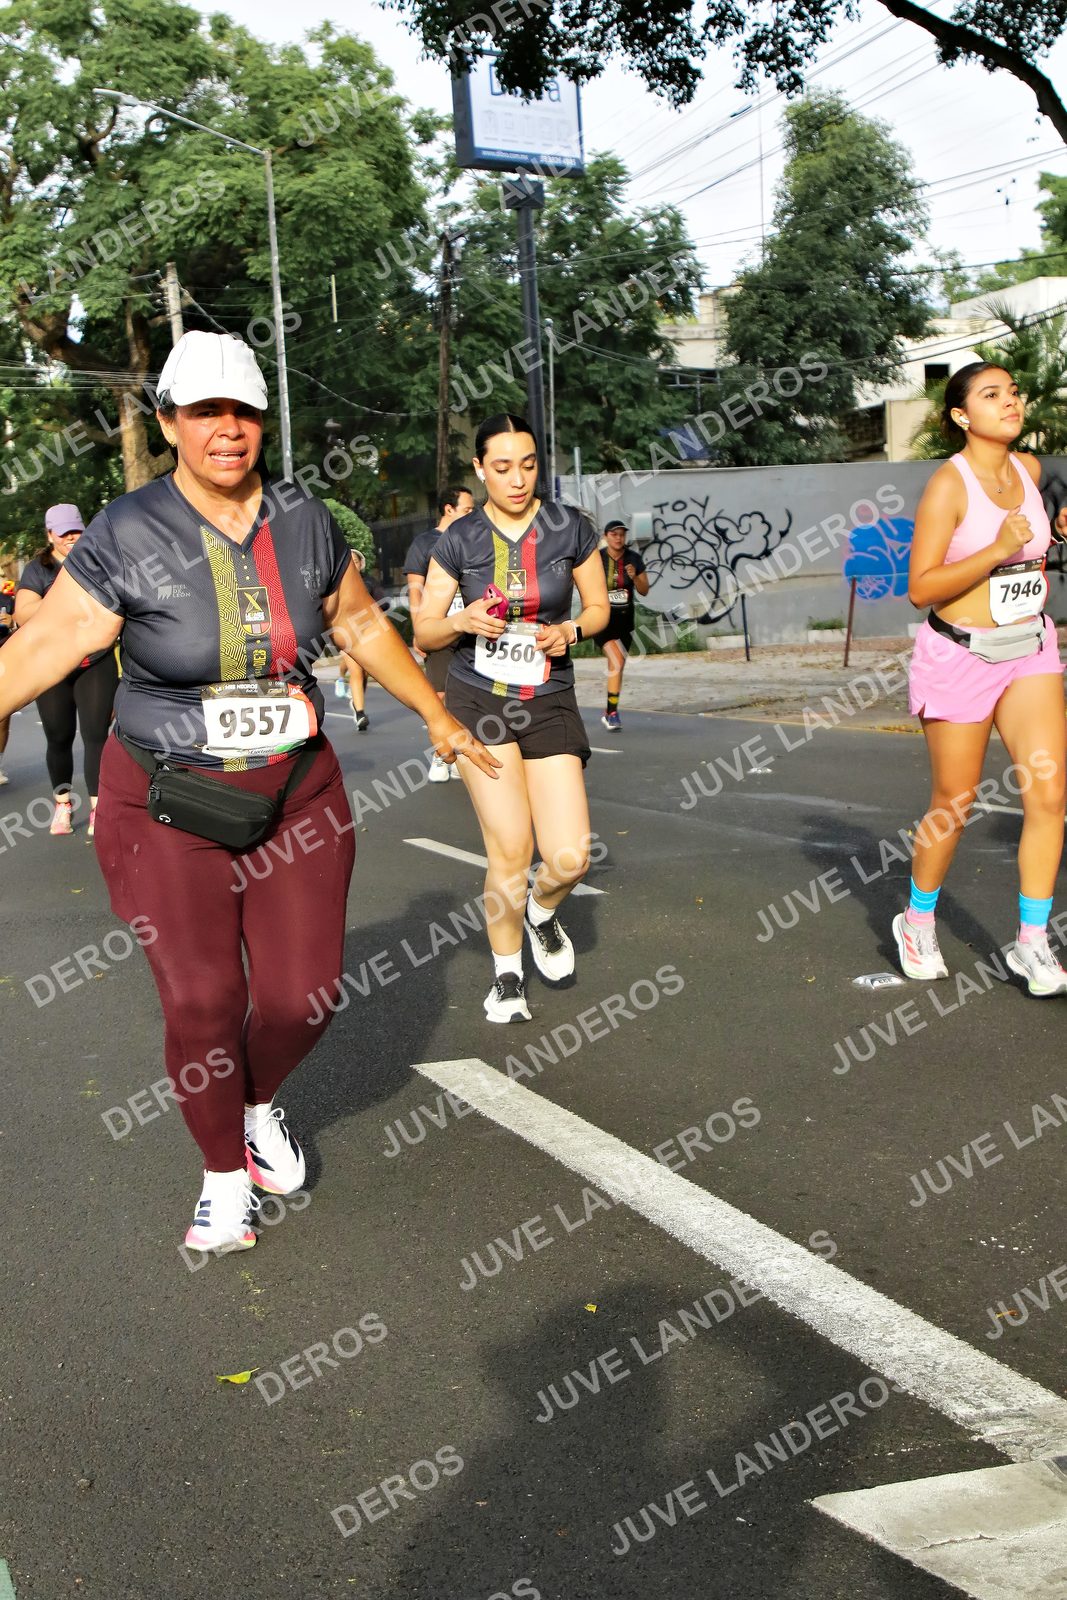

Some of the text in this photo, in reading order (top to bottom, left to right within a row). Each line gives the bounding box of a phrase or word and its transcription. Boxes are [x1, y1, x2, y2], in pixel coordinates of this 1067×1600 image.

[653, 496, 709, 518] TOY
[1000, 578, 1042, 603] 7946
[485, 640, 535, 663] 9560
[219, 704, 291, 739] 9557
